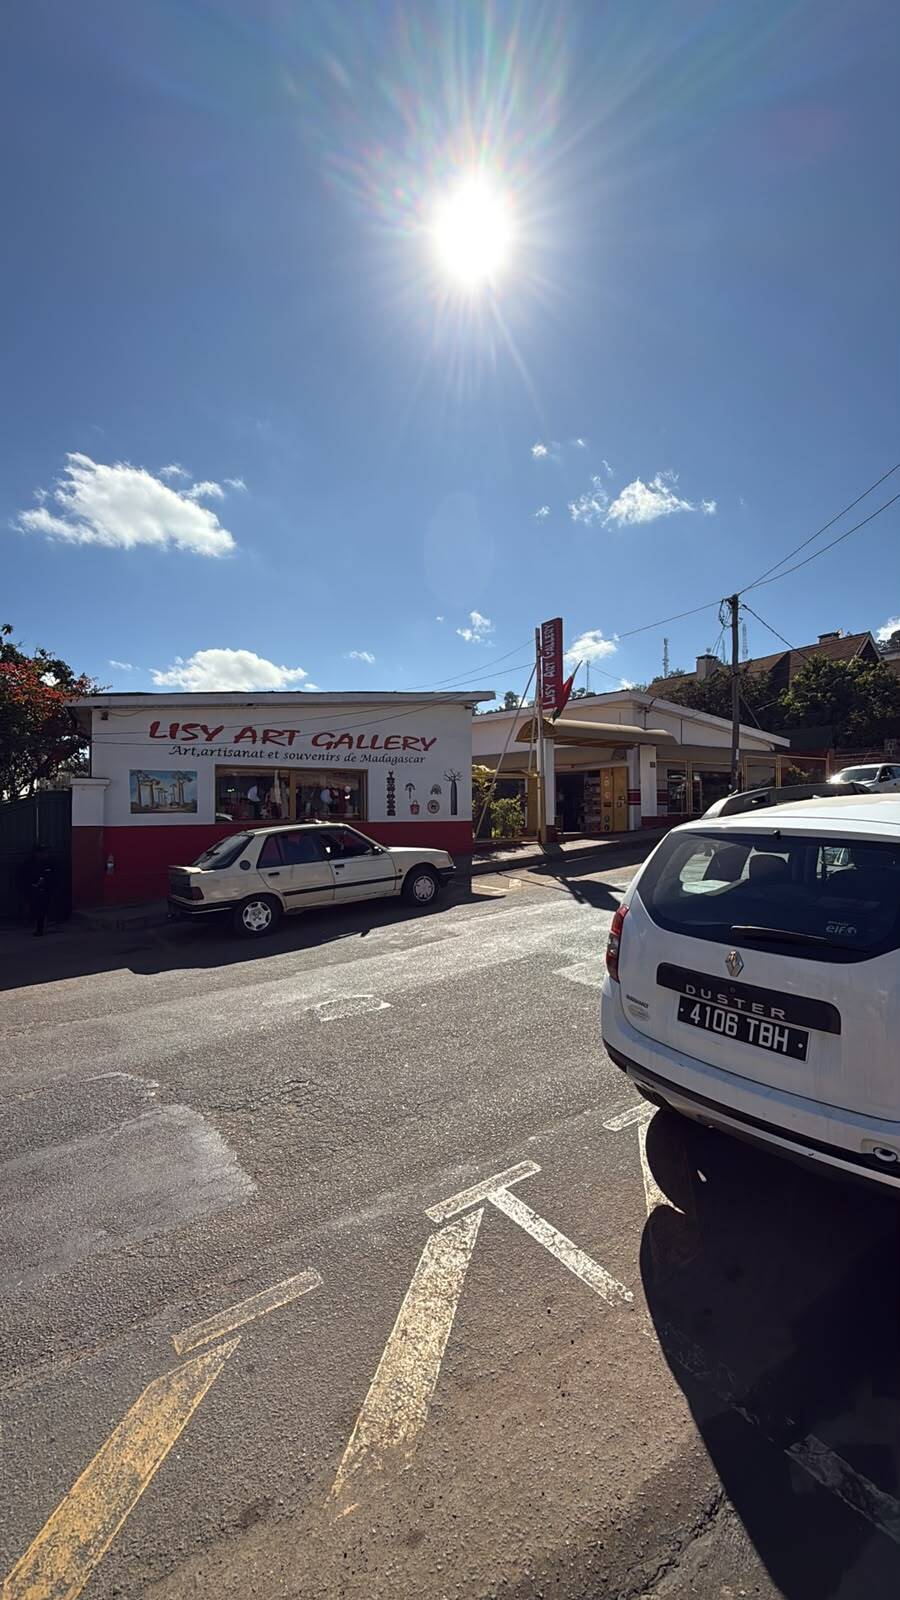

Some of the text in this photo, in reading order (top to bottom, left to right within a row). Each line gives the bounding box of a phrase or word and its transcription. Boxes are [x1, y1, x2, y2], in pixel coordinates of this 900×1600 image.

[543, 624, 556, 705] LISY ART GALLERY
[149, 720, 437, 752] LISY ART GALLERY
[267, 750, 279, 760] et
[283, 751, 341, 763] souvenirs
[344, 752, 356, 763] de
[359, 754, 426, 766] Madagascar
[685, 983, 786, 1020] DUSTER
[690, 1003, 739, 1037] 4106
[746, 1018, 790, 1053] TBH
